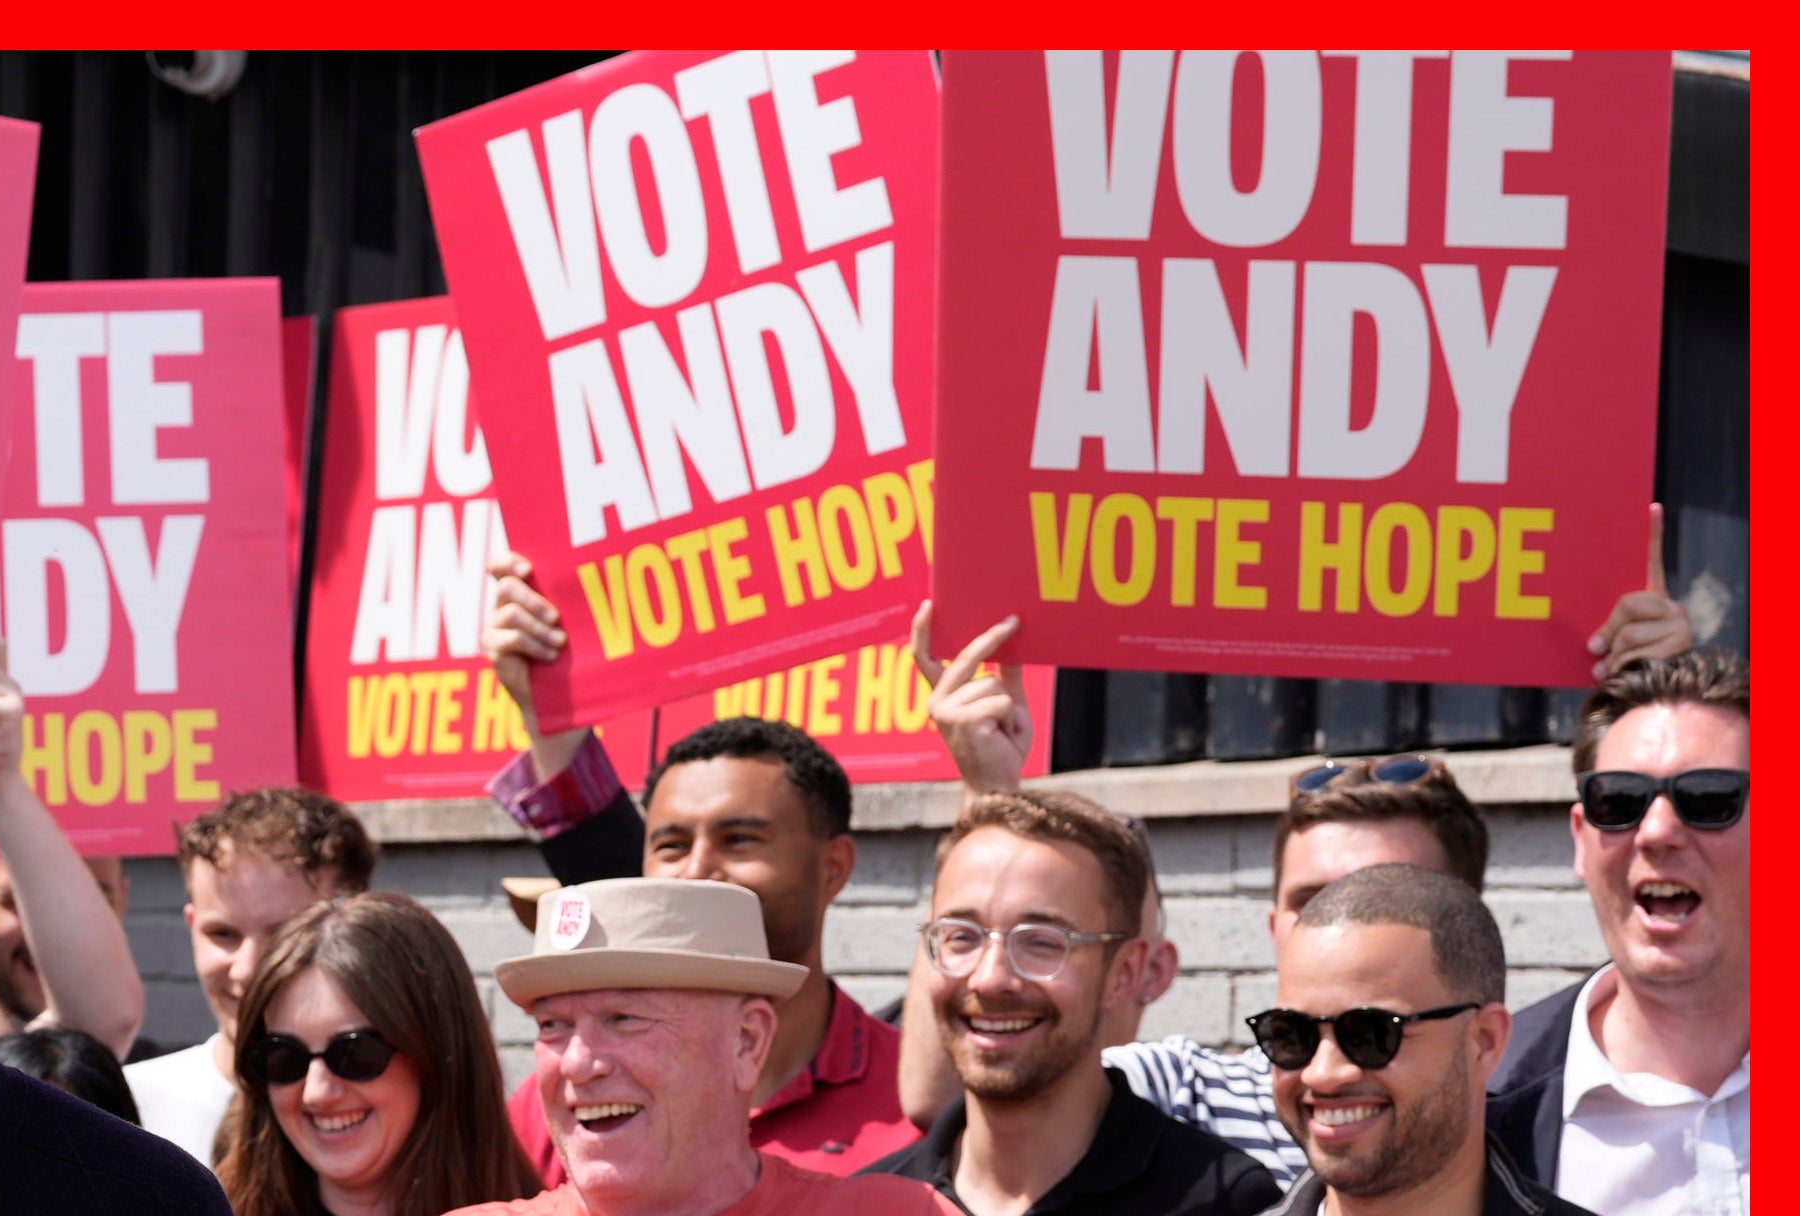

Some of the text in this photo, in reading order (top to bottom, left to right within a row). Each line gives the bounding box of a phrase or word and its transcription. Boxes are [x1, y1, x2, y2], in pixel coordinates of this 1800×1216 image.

[486, 50, 894, 342] VOTE
[1043, 50, 1573, 250] VOTE
[15, 308, 211, 508] TE
[375, 323, 493, 497] VO
[547, 240, 906, 548] ANDY
[1030, 254, 1560, 484] ANDY
[349, 498, 510, 665] AN
[577, 517, 767, 661] VOTE
[1029, 491, 1555, 620] VOTE HOPE
[20, 708, 222, 807] HOPE
[346, 669, 468, 758] VOTE
